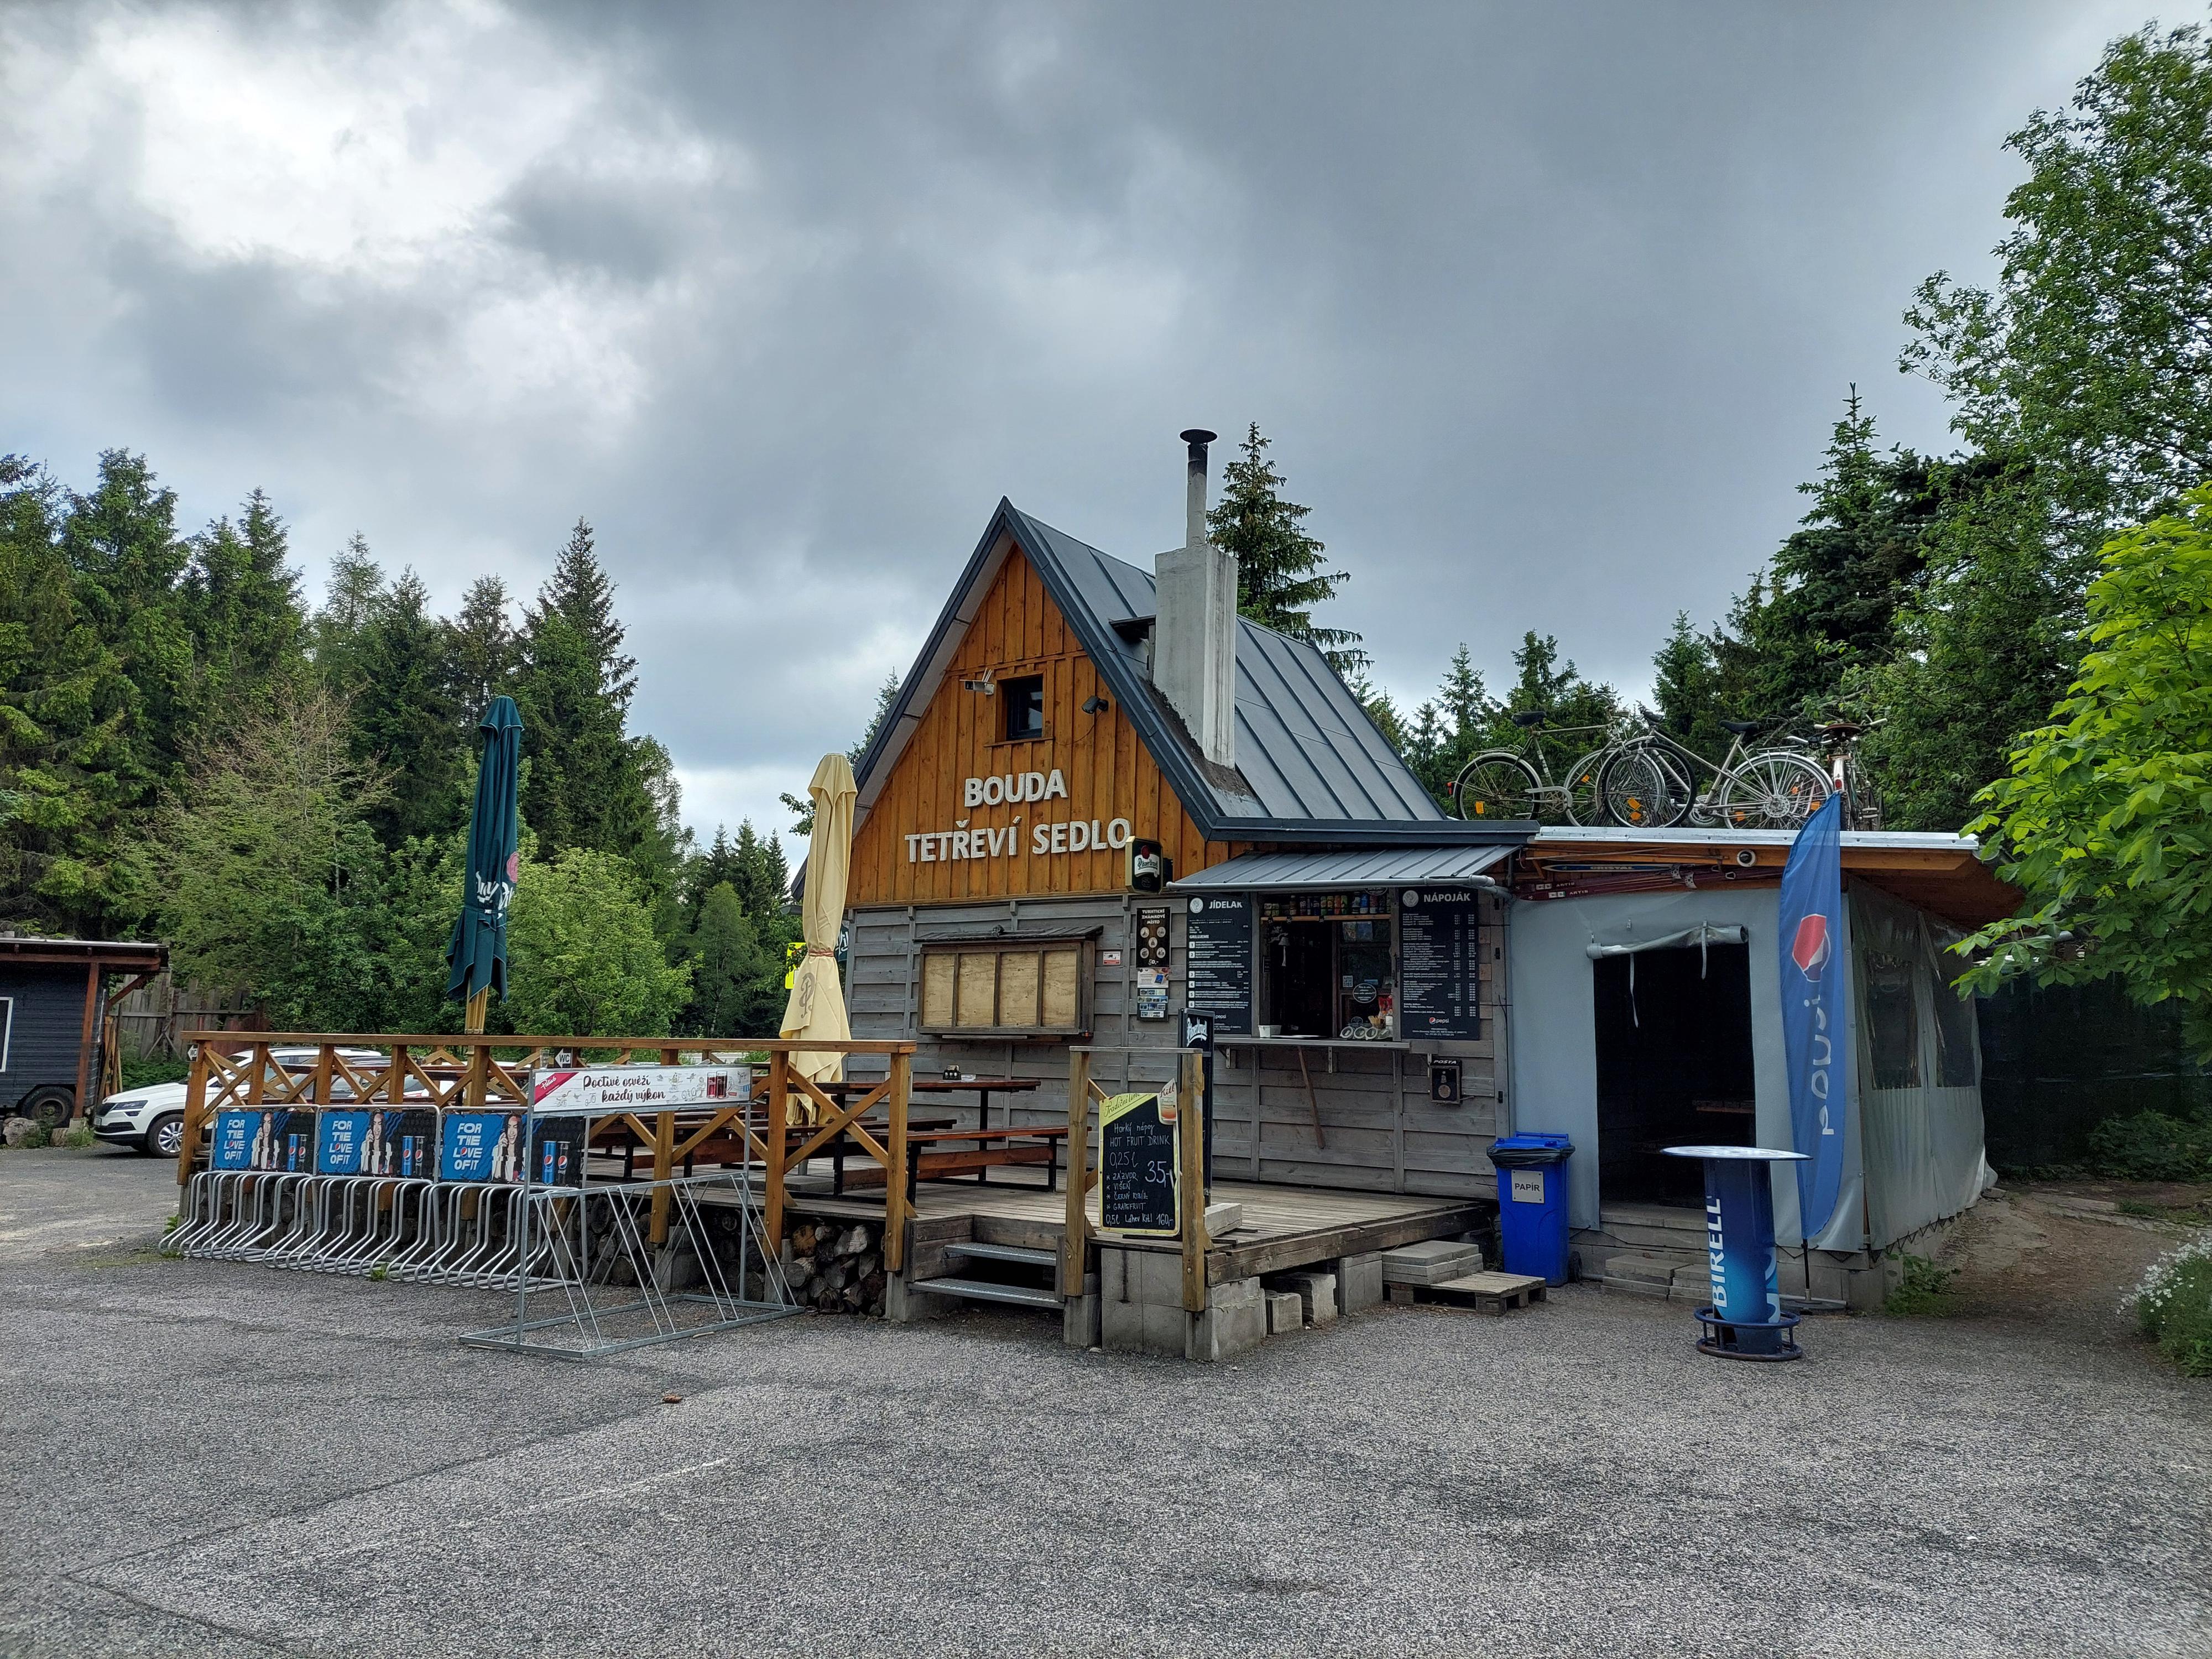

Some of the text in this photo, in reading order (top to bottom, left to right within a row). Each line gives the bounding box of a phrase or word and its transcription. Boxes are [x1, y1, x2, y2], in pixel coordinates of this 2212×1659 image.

[964, 769, 1068, 807] BOUDA
[905, 816, 1131, 863] TETŘEVÍ SEDLO
[1423, 891, 1471, 902] NÁPOJÁK
[583, 1074, 651, 1091] Poctivě osvěží
[602, 1088, 666, 1103] každý výkon
[1104, 1095, 1128, 1117] Tradiční
[227, 1119, 245, 1129] FOR
[332, 1120, 352, 1130] FOR
[457, 1123, 482, 1133] FOR
[1114, 1121, 1155, 1135] Horký nápoj
[1110, 1135, 1171, 1147] HOT FRUIT DRINK
[1110, 1151, 1129, 1168] 0,25
[1113, 1170, 1138, 1181] ZÁZVOR
[1515, 1182, 1540, 1192] PAPÍR
[1114, 1191, 1130, 1200] ČERNÝ
[1113, 1202, 1146, 1211] GRAPEFRUIT
[1156, 1213, 1173, 1227] 160,-
[1707, 1198, 1728, 1308] BIRELL
